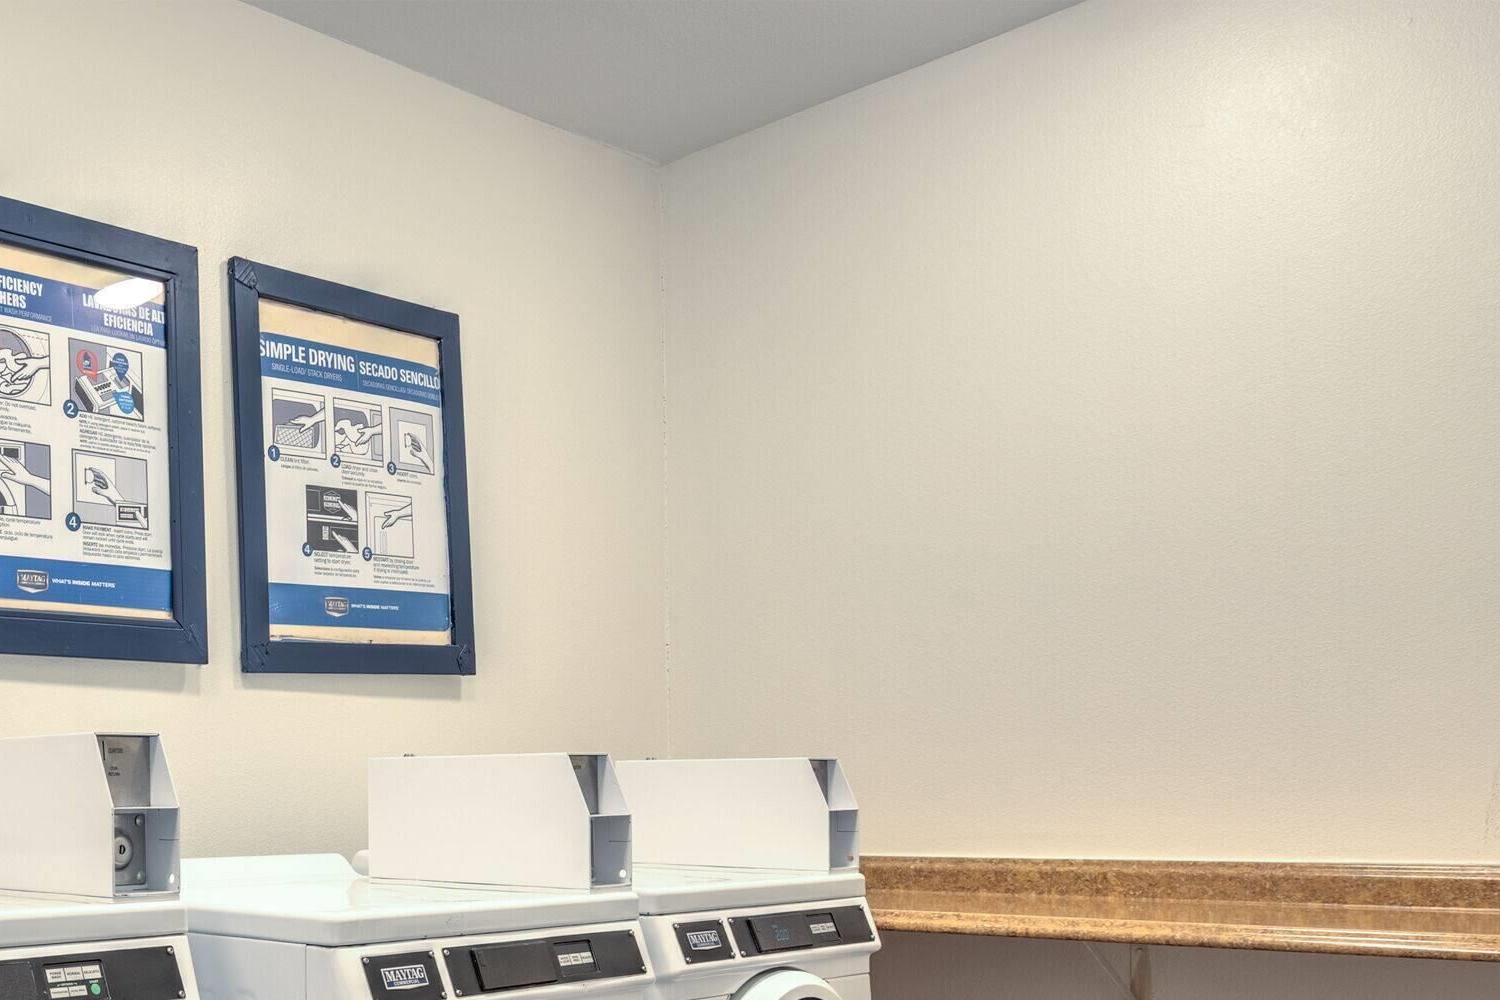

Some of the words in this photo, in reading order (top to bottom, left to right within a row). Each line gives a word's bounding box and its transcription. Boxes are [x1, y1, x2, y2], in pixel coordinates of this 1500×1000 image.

[4, 307, 18, 315] WASH
[19, 309, 52, 322] PERFORMANCE
[139, 307, 150, 320] DE
[104, 313, 153, 336] EFICIENCIA
[260, 339, 306, 364] SIMPLE
[309, 348, 355, 372] DRYING
[360, 362, 398, 381] SECADO
[400, 369, 440, 390] SENCILLO
[324, 371, 343, 382] DRYERS
[67, 403, 75, 415] 2
[271, 448, 276, 457] 1
[333, 456, 338, 466] 2
[389, 464, 394, 473] 3
[69, 517, 77, 528] 4
[304, 545, 310, 553] 4
[364, 550, 370, 558] 5
[690, 932, 718, 944] MAYTAG
[384, 967, 424, 982] MAYTAG
